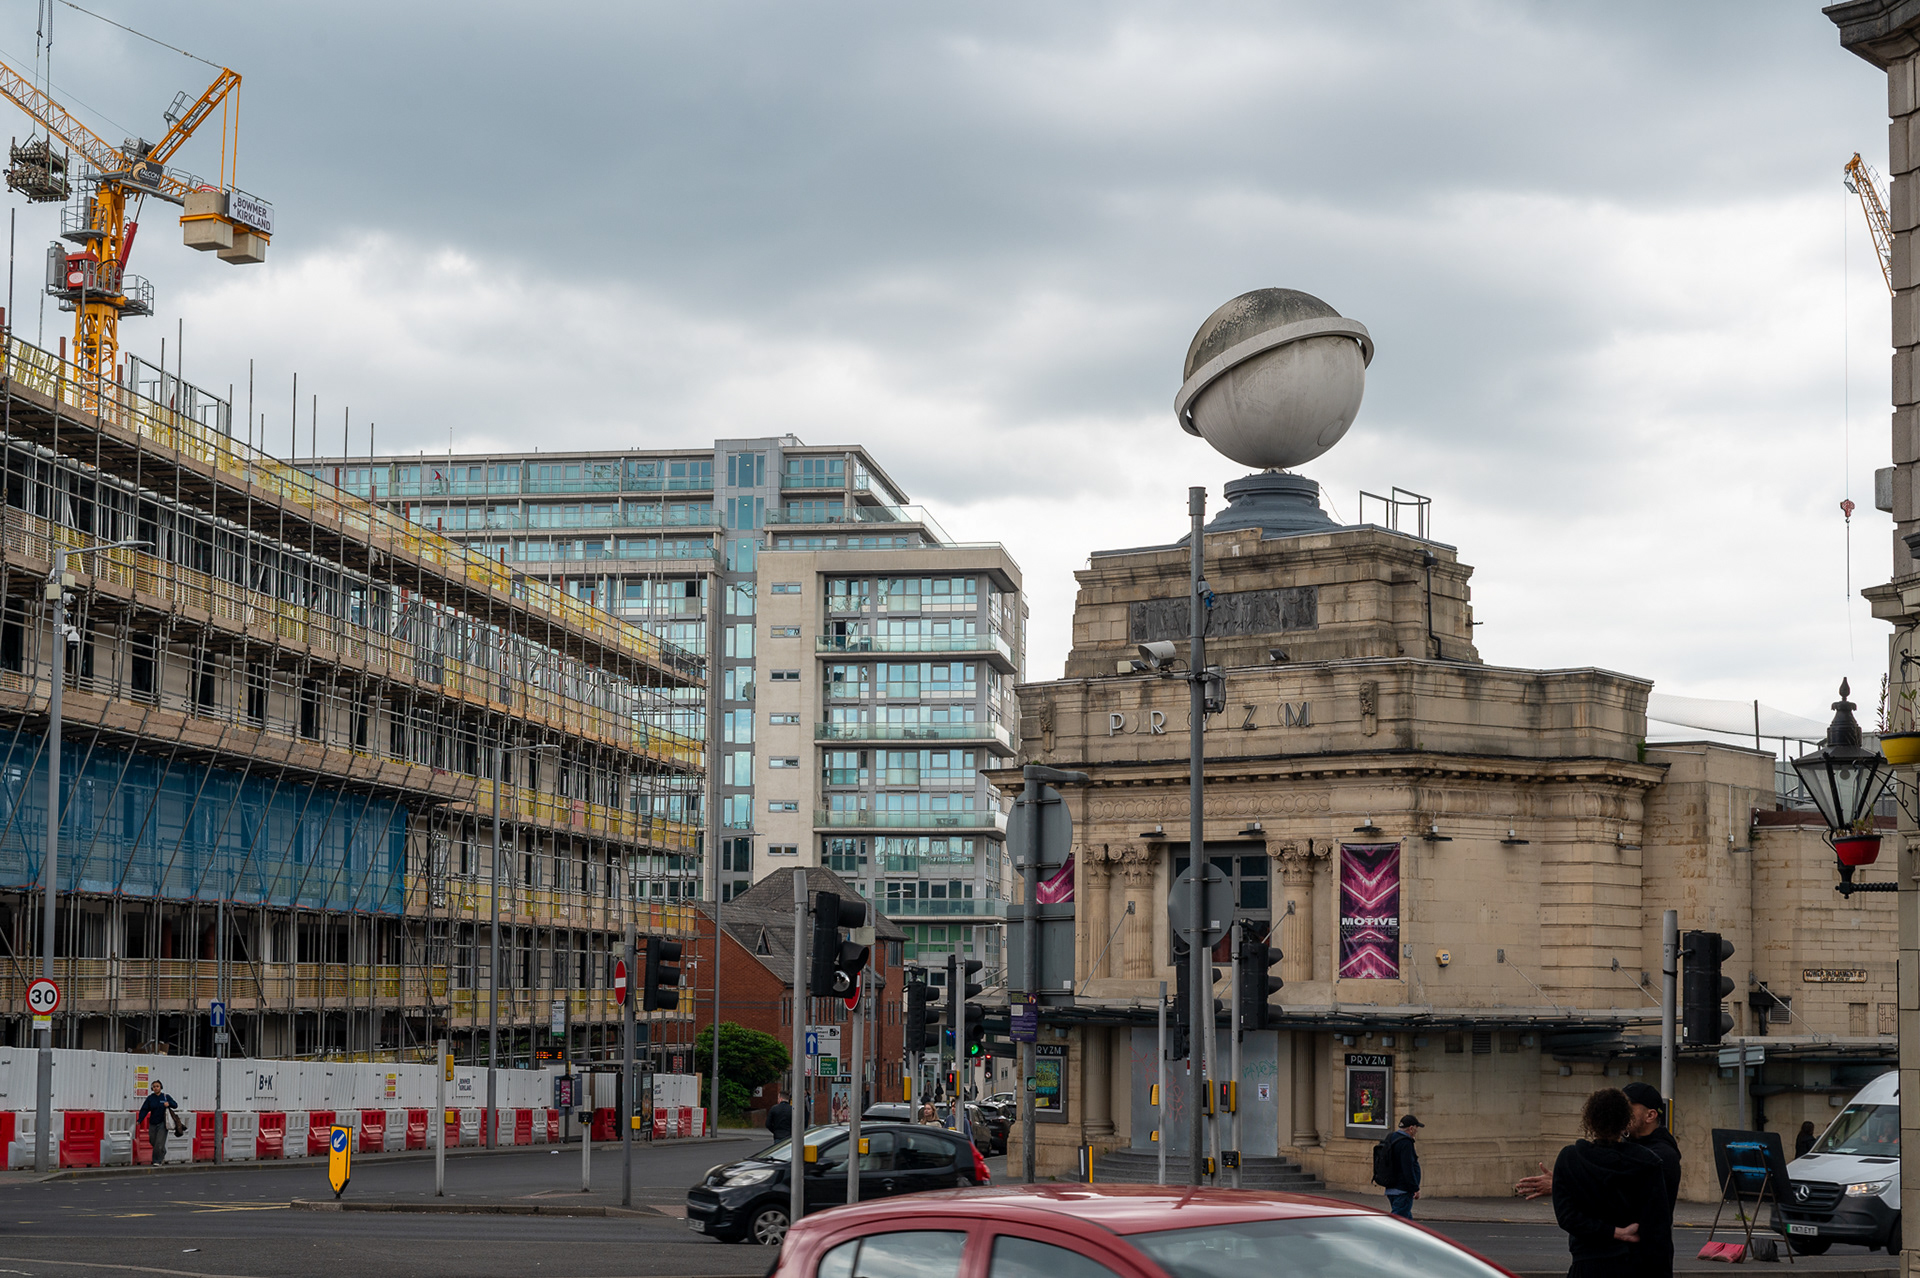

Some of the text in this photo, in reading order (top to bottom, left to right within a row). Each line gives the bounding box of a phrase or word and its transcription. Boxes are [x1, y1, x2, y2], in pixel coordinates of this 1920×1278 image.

[140, 168, 160, 180] FALCON
[237, 197, 267, 218] BOWMER
[236, 209, 271, 231] KIRKLAND
[1341, 917, 1398, 926] MOTIVE
[31, 989, 56, 1005] 30
[1036, 1045, 1062, 1055] RYZM
[1350, 1055, 1386, 1065] PRYZM
[259, 1074, 273, 1090] B+K
